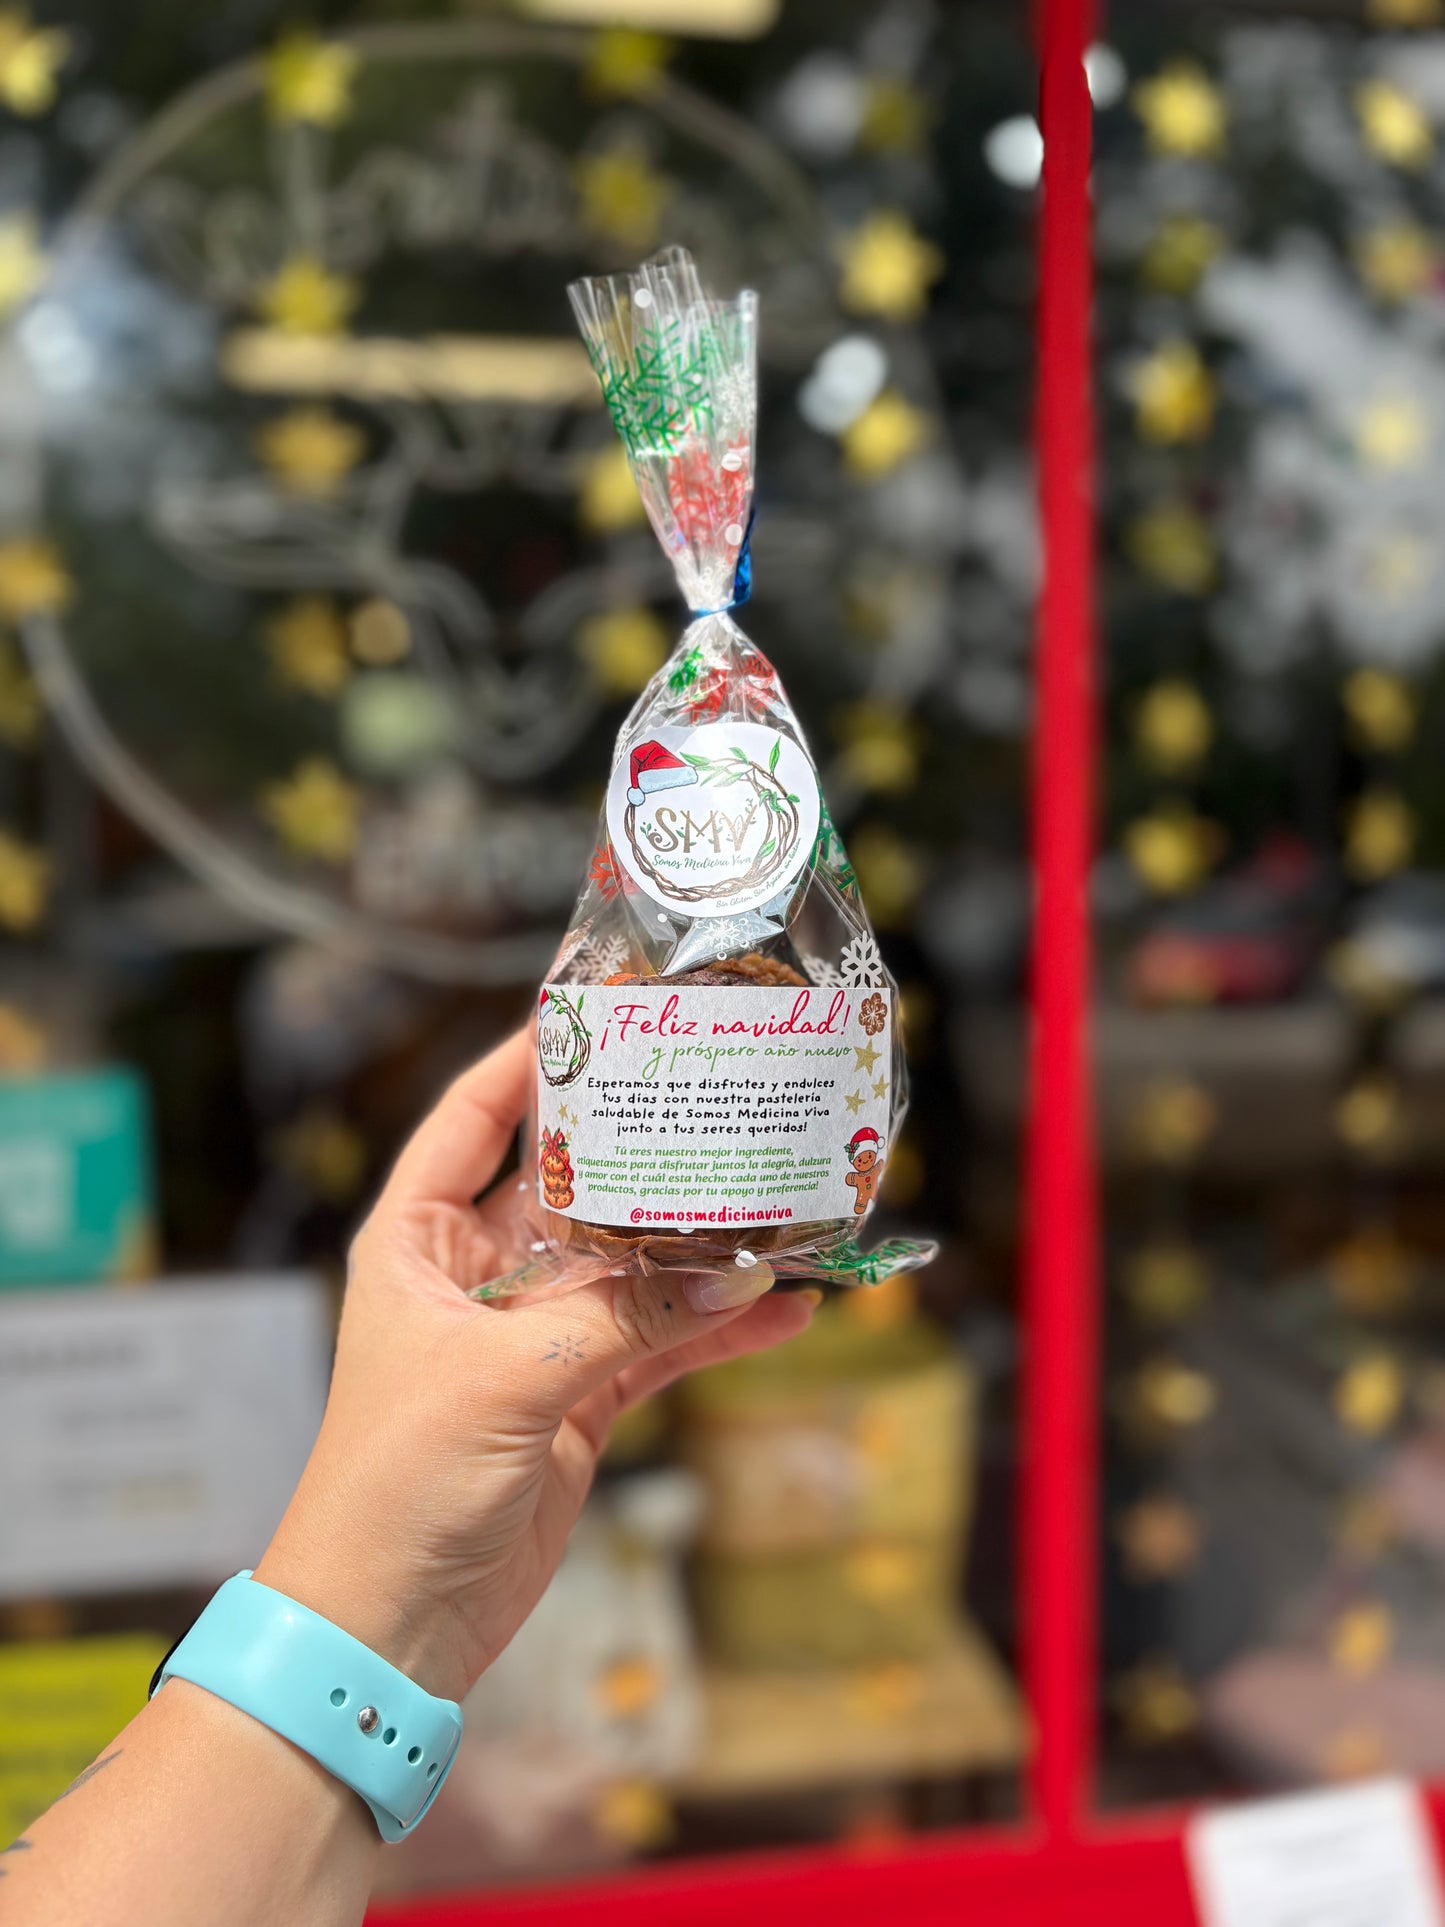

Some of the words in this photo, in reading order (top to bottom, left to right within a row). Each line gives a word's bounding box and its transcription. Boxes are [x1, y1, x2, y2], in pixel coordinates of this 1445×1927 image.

[652, 854, 681, 869] Somos
[684, 857, 729, 870] Medicina
[600, 994, 700, 1051] ¡Feliz
[712, 989, 851, 1038] navidad!
[642, 1046, 666, 1080] y
[668, 1041, 759, 1073] próspero
[764, 1044, 800, 1057] año
[805, 1047, 852, 1058] nuevo
[588, 1077, 660, 1091] Esperamos
[667, 1081, 692, 1093] que
[698, 1078, 765, 1090] disfrutes
[771, 1081, 779, 1093] y
[784, 1077, 835, 1089] endulces
[602, 1092, 621, 1104] tus
[627, 1092, 657, 1104] días
[664, 1096, 689, 1104] con
[696, 1093, 751, 1104] nuestra
[757, 1092, 821, 1107] pastelería
[591, 1107, 655, 1119] saludable
[662, 1108, 679, 1119] de
[686, 1108, 731, 1119] Somos
[738, 1107, 799, 1119] Medicina
[805, 1106, 830, 1117] Viva
[617, 1122, 653, 1137] junto
[674, 1123, 695, 1134] tus
[701, 1126, 741, 1134] seres
[748, 1121, 807, 1137] queridos!
[614, 1145, 627, 1155] Tú
[629, 1148, 652, 1156] eres
[655, 1148, 697, 1157] nuestro
[700, 1148, 732, 1159] mejor
[735, 1147, 794, 1159] ingrediente,
[576, 1156, 627, 1168] etiquetanos
[630, 1160, 656, 1171] para
[659, 1160, 709, 1171] disfrutar
[711, 1160, 746, 1171] juntos
[749, 1160, 758, 1169] la
[761, 1158, 796, 1170] alegría,
[798, 1157, 832, 1167] dulzura
[578, 1170, 583, 1179] y
[584, 1170, 608, 1180] amor
[610, 1173, 627, 1181] con
[630, 1172, 640, 1182] el
[642, 1172, 666, 1182] cuál
[668, 1174, 691, 1183] esta
[695, 1173, 728, 1183] hecho
[731, 1173, 757, 1183] cada
[780, 1171, 791, 1180] de
[793, 1169, 829, 1180] nuestros
[588, 1183, 637, 1195] productos,
[639, 1186, 680, 1197] gracias
[683, 1188, 703, 1197] por
[706, 1187, 717, 1195] tu
[721, 1188, 754, 1197] apoyo
[757, 1188, 764, 1197] y
[766, 1181, 819, 1196] preferencia!
[630, 1205, 793, 1223] @somosmedicinaviva
